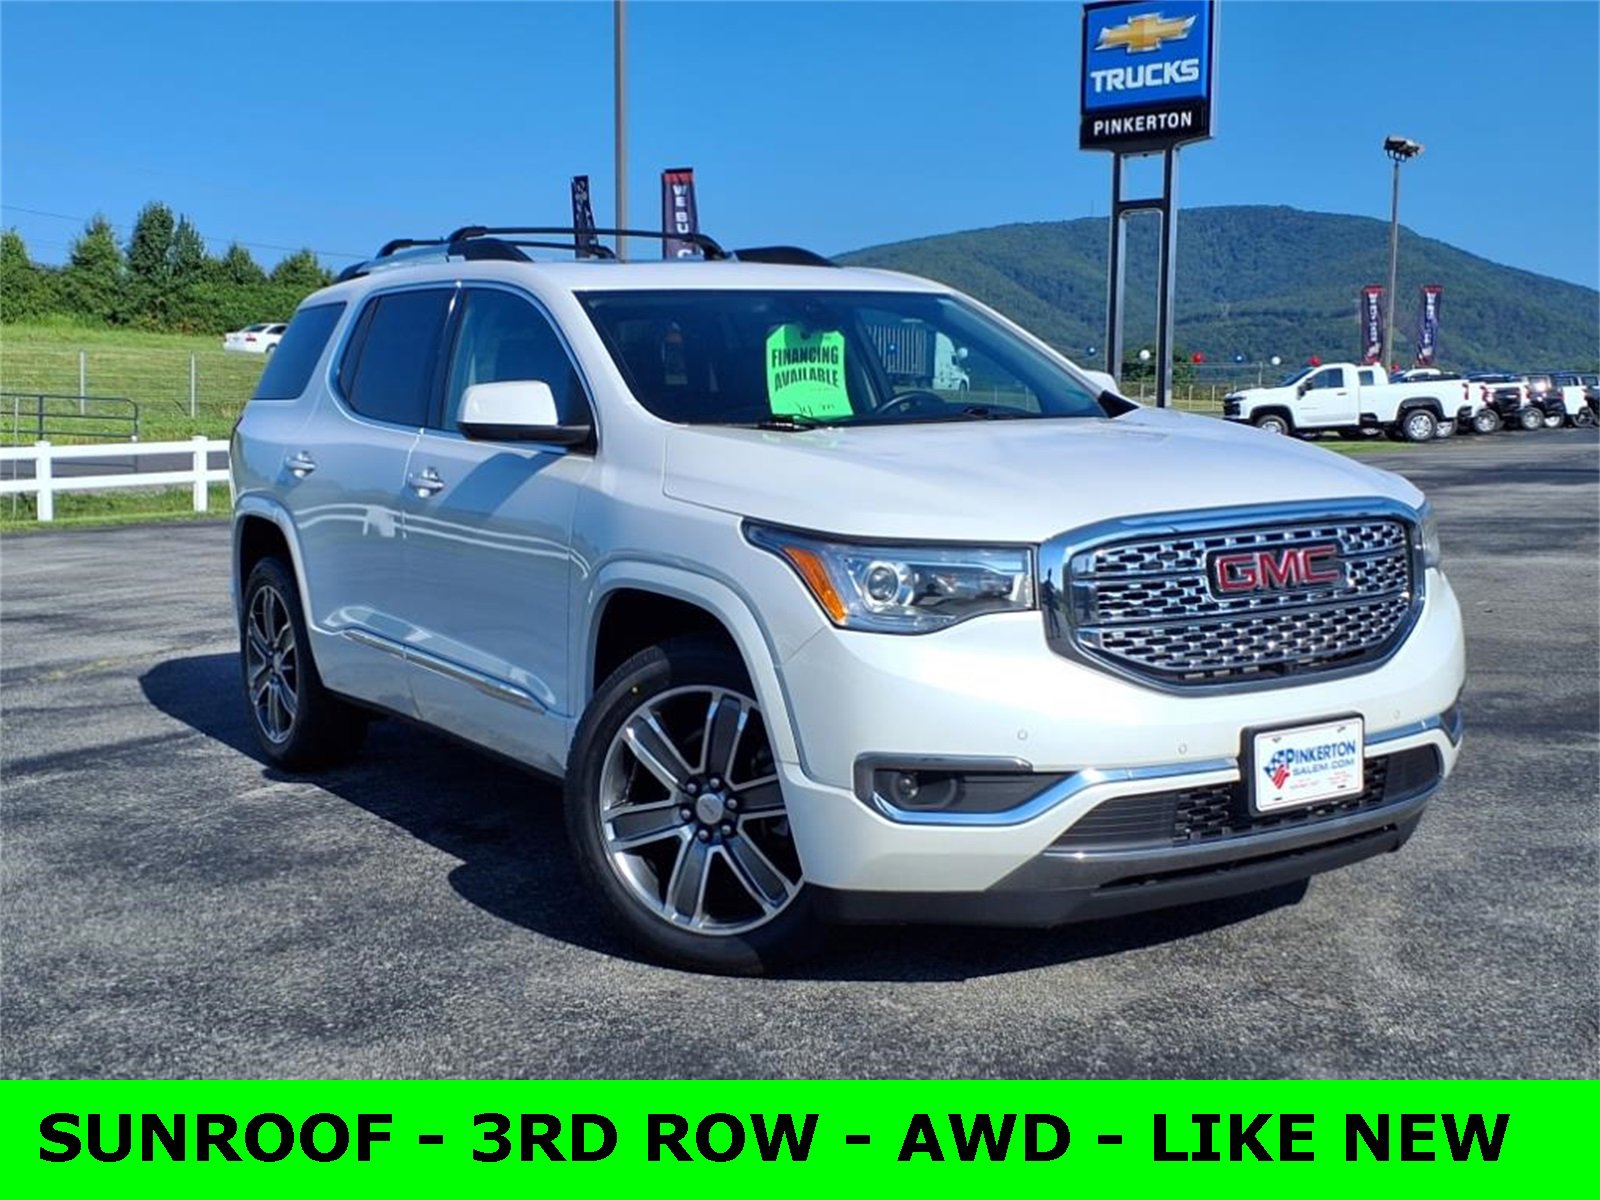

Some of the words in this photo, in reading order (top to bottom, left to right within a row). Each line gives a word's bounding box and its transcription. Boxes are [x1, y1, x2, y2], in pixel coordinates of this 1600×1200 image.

[1090, 58, 1200, 93] TRUCKS
[1093, 111, 1193, 137] PINKERTON
[771, 344, 840, 369] FINANCING
[774, 366, 840, 393] AVAILABLE
[1215, 544, 1340, 592] GMC
[1286, 740, 1356, 765] PINKERTON
